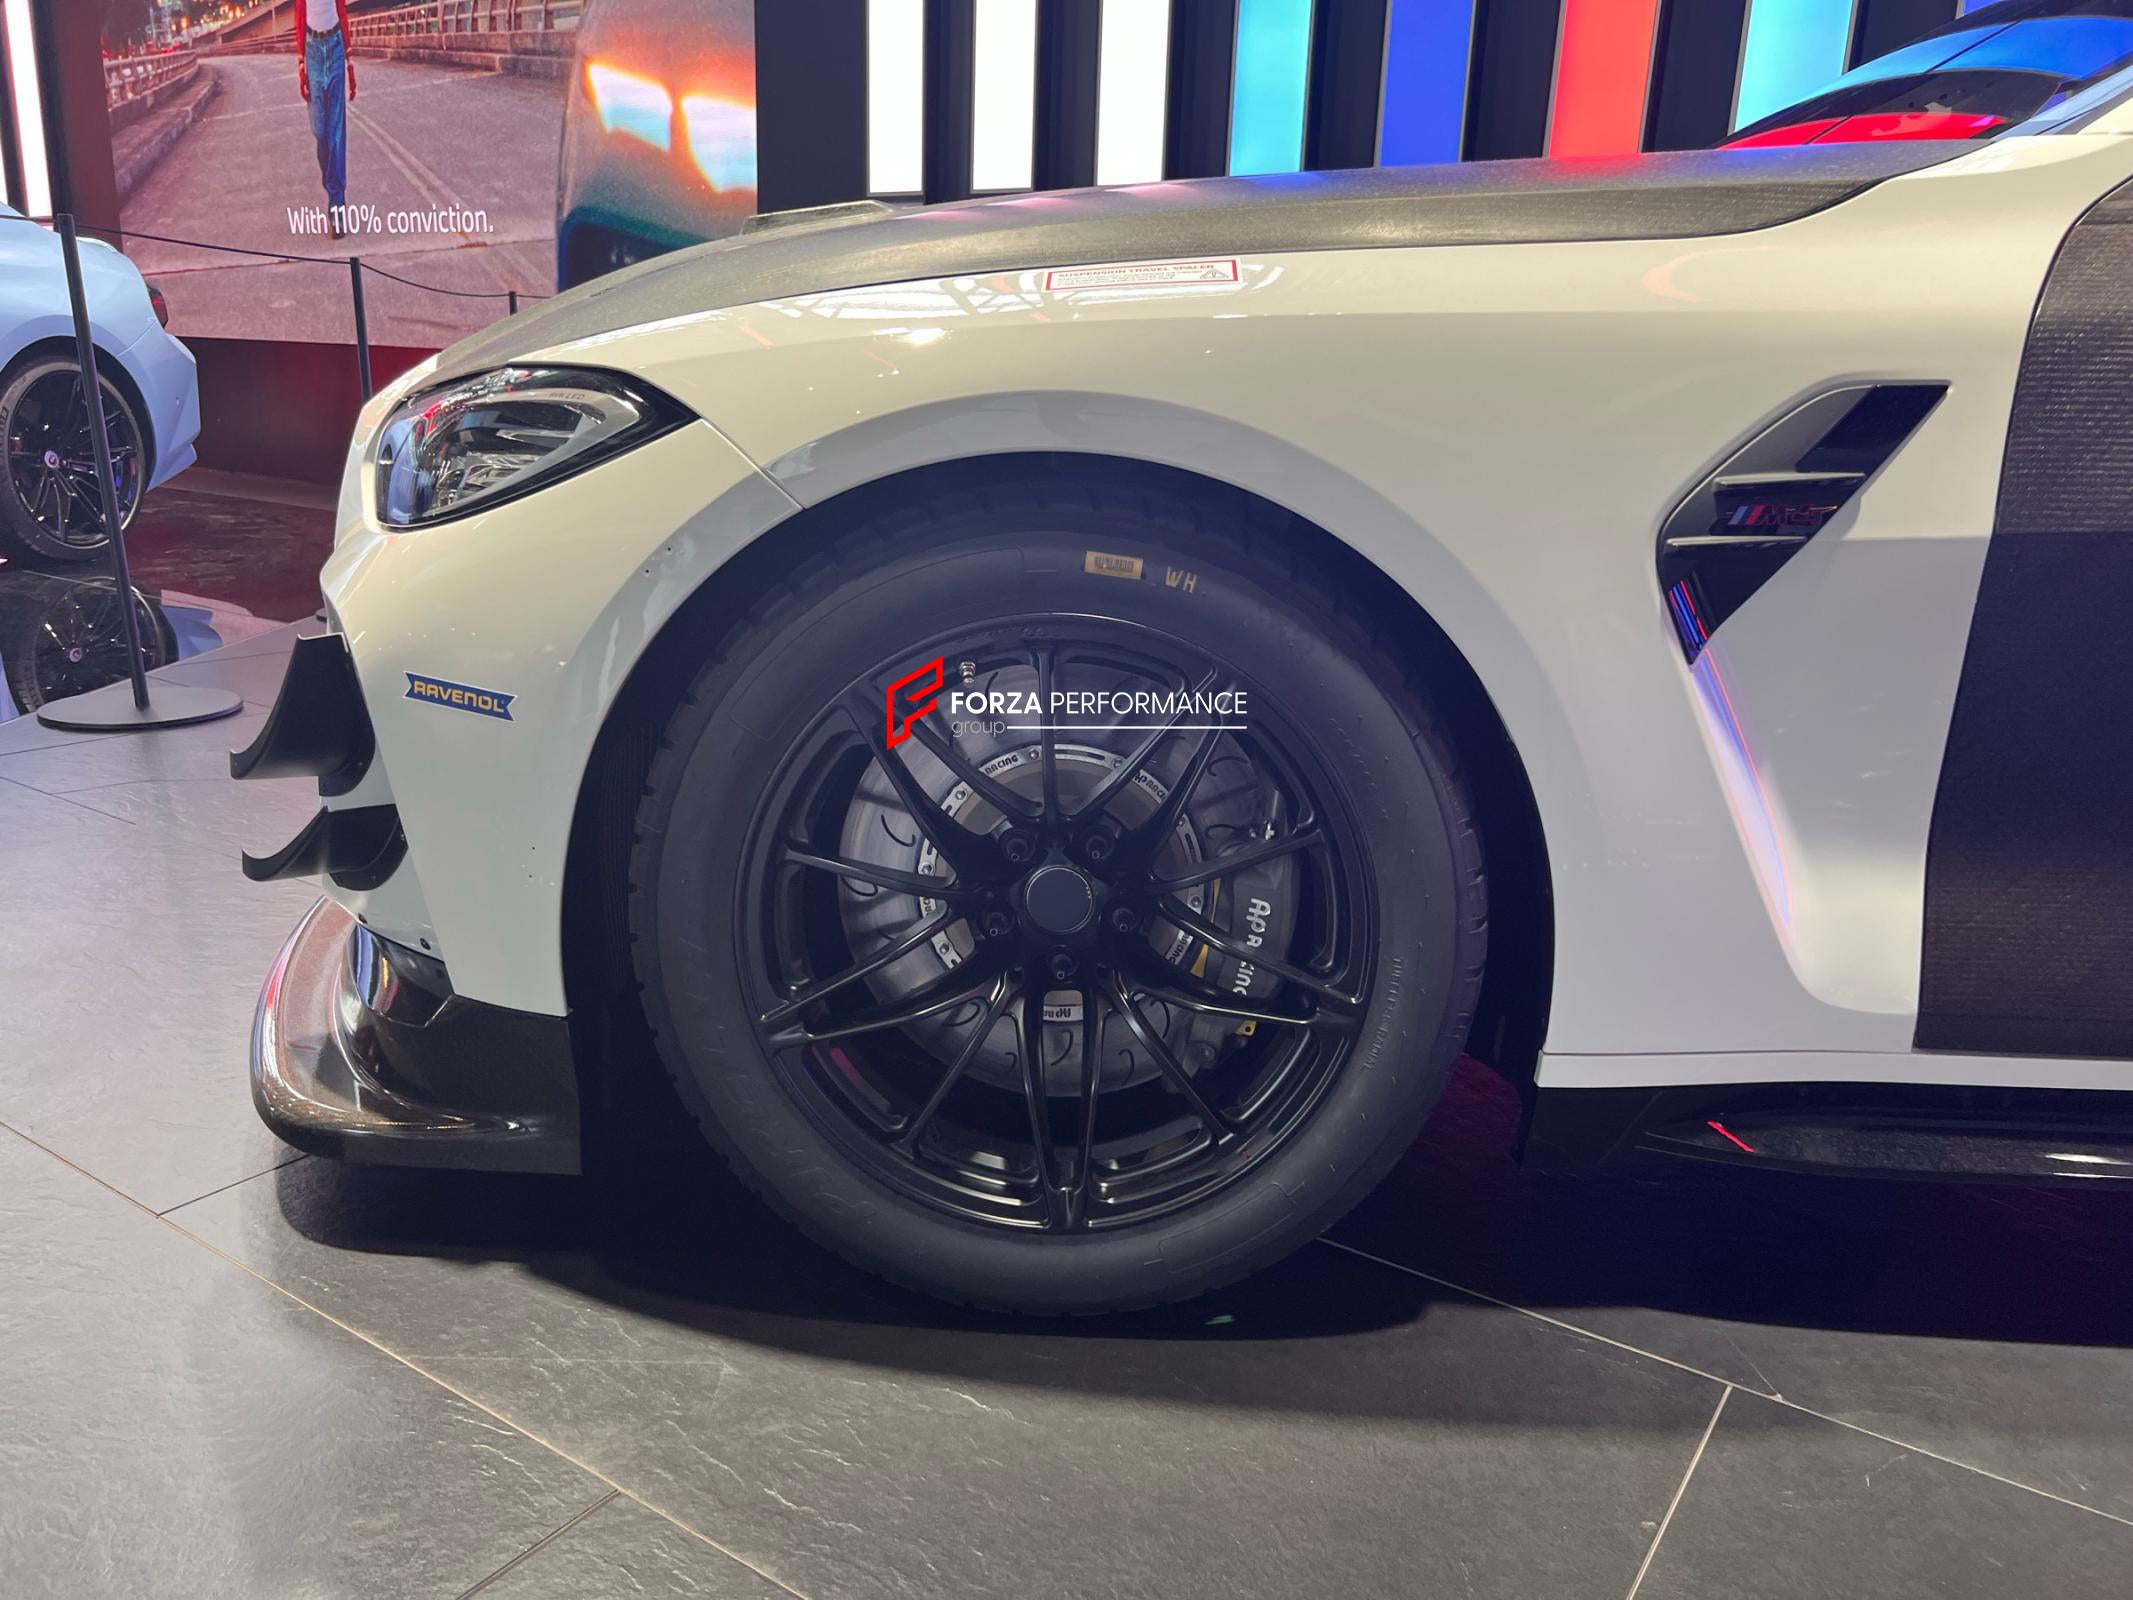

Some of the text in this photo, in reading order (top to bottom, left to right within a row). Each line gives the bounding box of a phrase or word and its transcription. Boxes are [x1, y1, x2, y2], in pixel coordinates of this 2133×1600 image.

[287, 203, 494, 235] With 110% conviction.
[413, 680, 505, 713] RAVENOL
